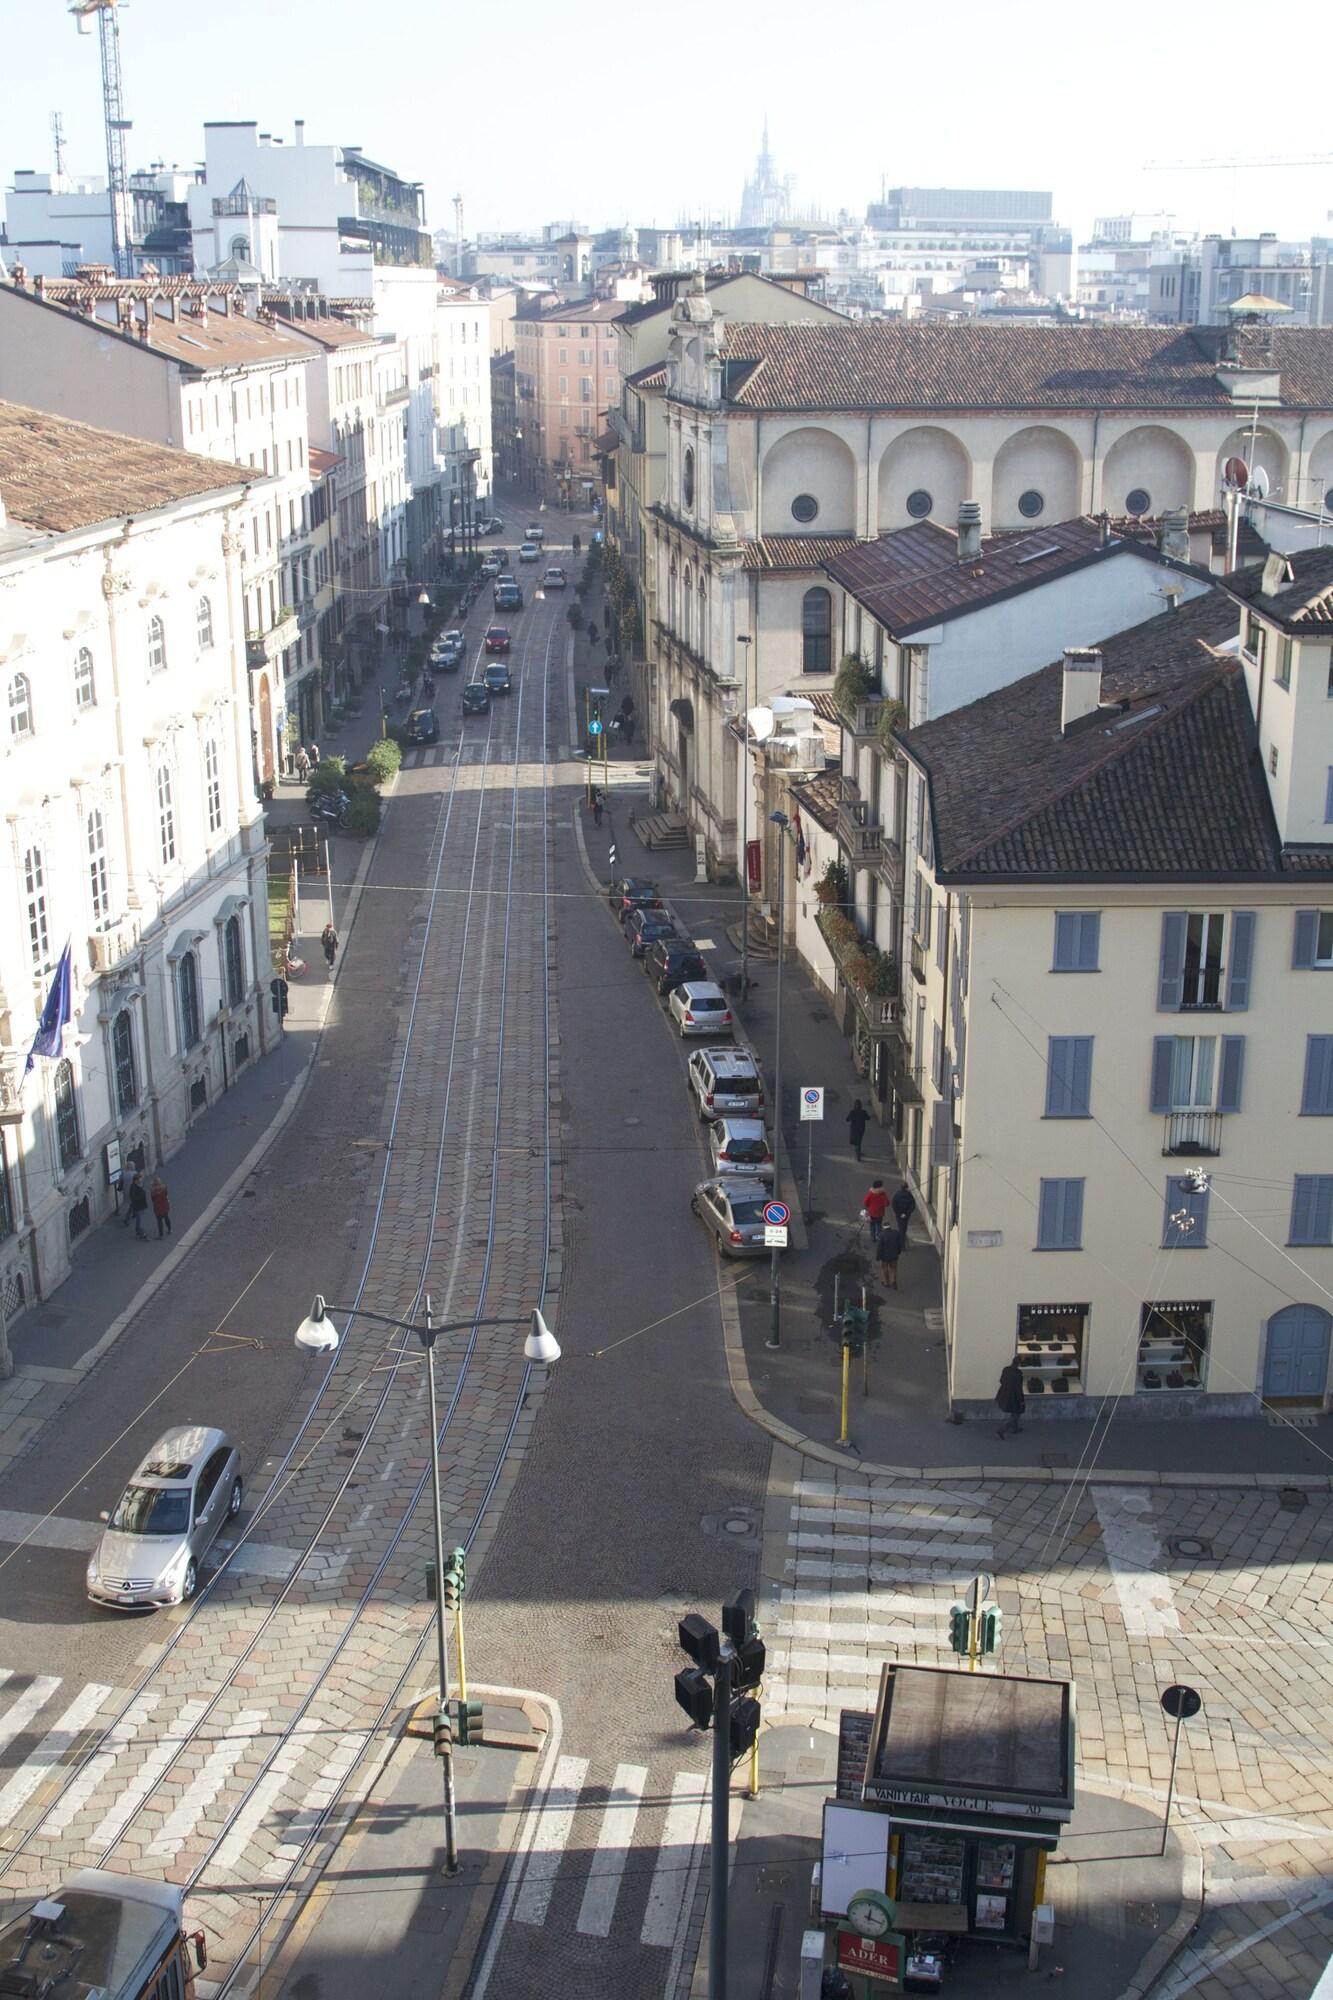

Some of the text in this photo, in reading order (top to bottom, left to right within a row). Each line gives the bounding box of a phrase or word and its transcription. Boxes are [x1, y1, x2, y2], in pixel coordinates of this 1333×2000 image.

[875, 1788, 930, 1804] VANITY FAIR
[943, 1795, 994, 1811] VOGUE
[1026, 1805, 1041, 1815] AD
[847, 1947, 888, 1965] ADER
